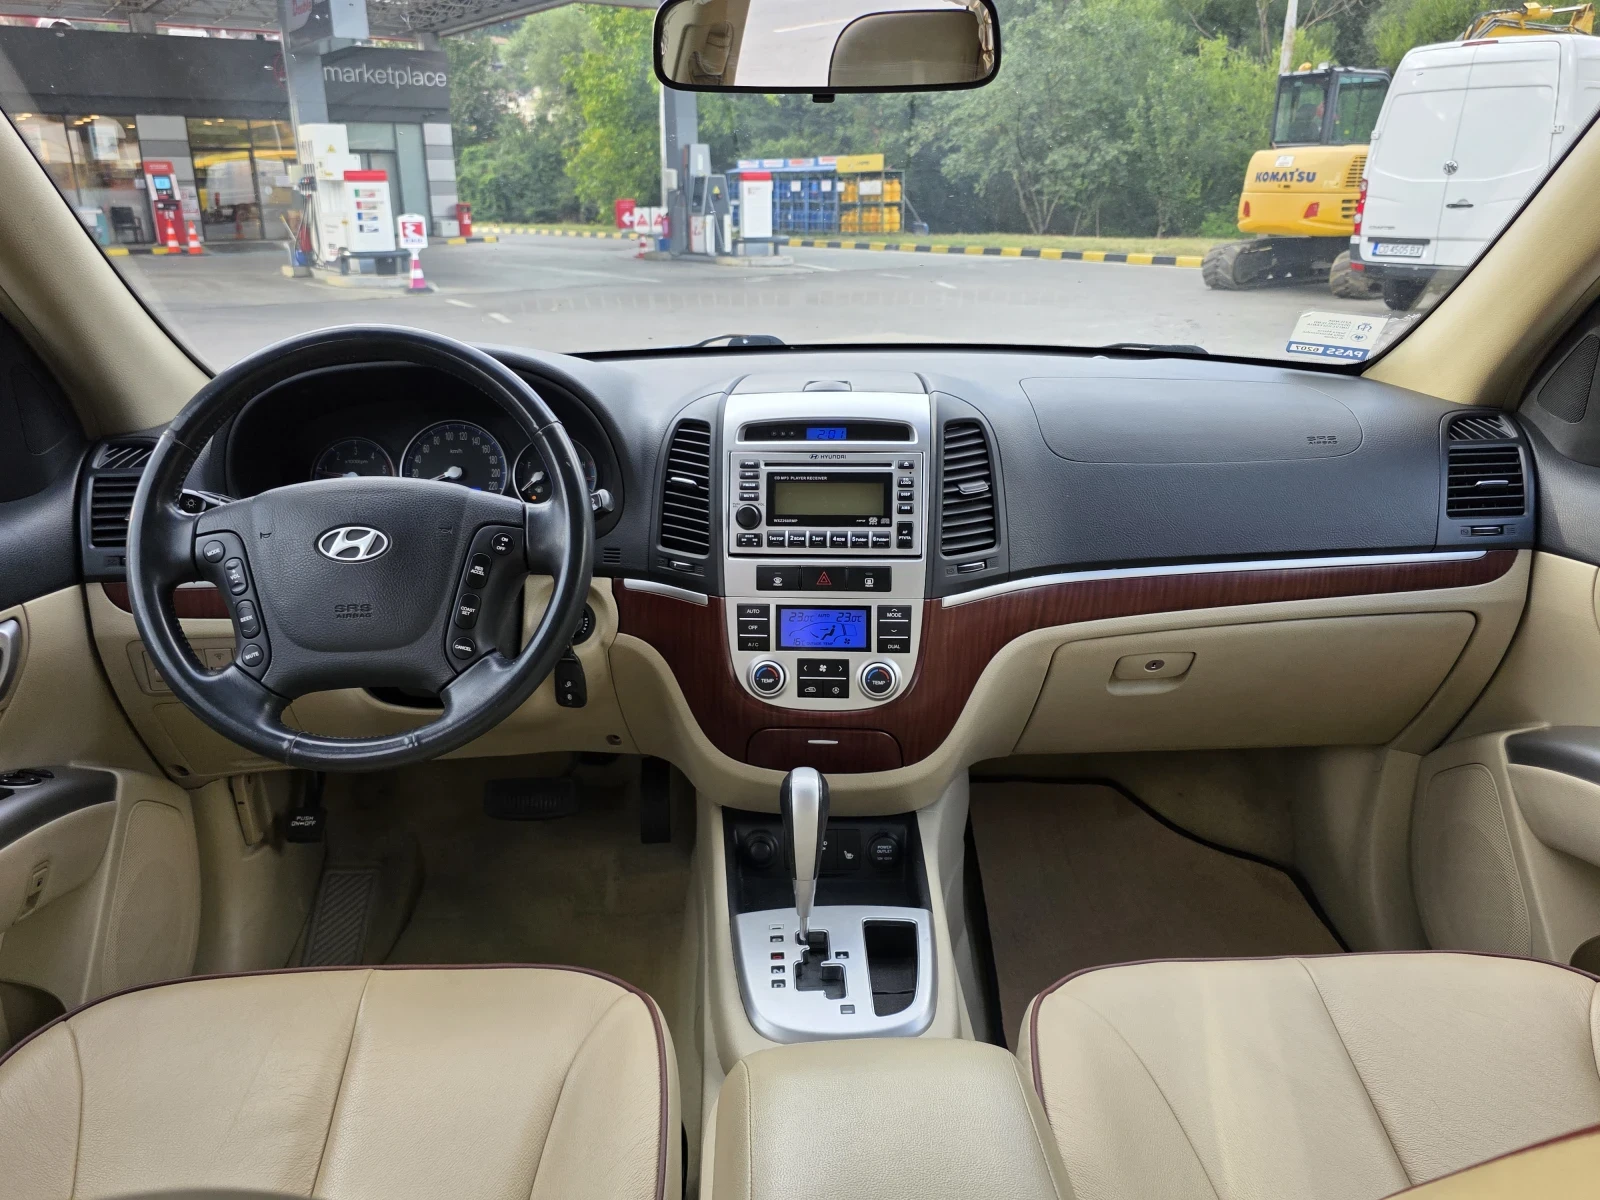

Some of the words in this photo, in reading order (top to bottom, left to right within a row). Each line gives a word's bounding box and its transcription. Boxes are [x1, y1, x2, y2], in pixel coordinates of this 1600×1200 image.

[323, 63, 446, 89] marketplace
[1255, 168, 1317, 183] KOMATSU
[445, 432, 454, 441] 100
[459, 432, 468, 441] 120
[471, 437, 480, 446] 140
[422, 444, 430, 453] 60
[481, 445, 491, 454] 160
[489, 456, 498, 465] 180
[412, 469, 419, 478] 20
[491, 469, 501, 478] 200
[488, 482, 498, 491] 220
[207, 548, 220, 556] MODE
[334, 603, 373, 612] SRS
[455, 644, 472, 652] CANCEL
[245, 651, 259, 660] MUTE
